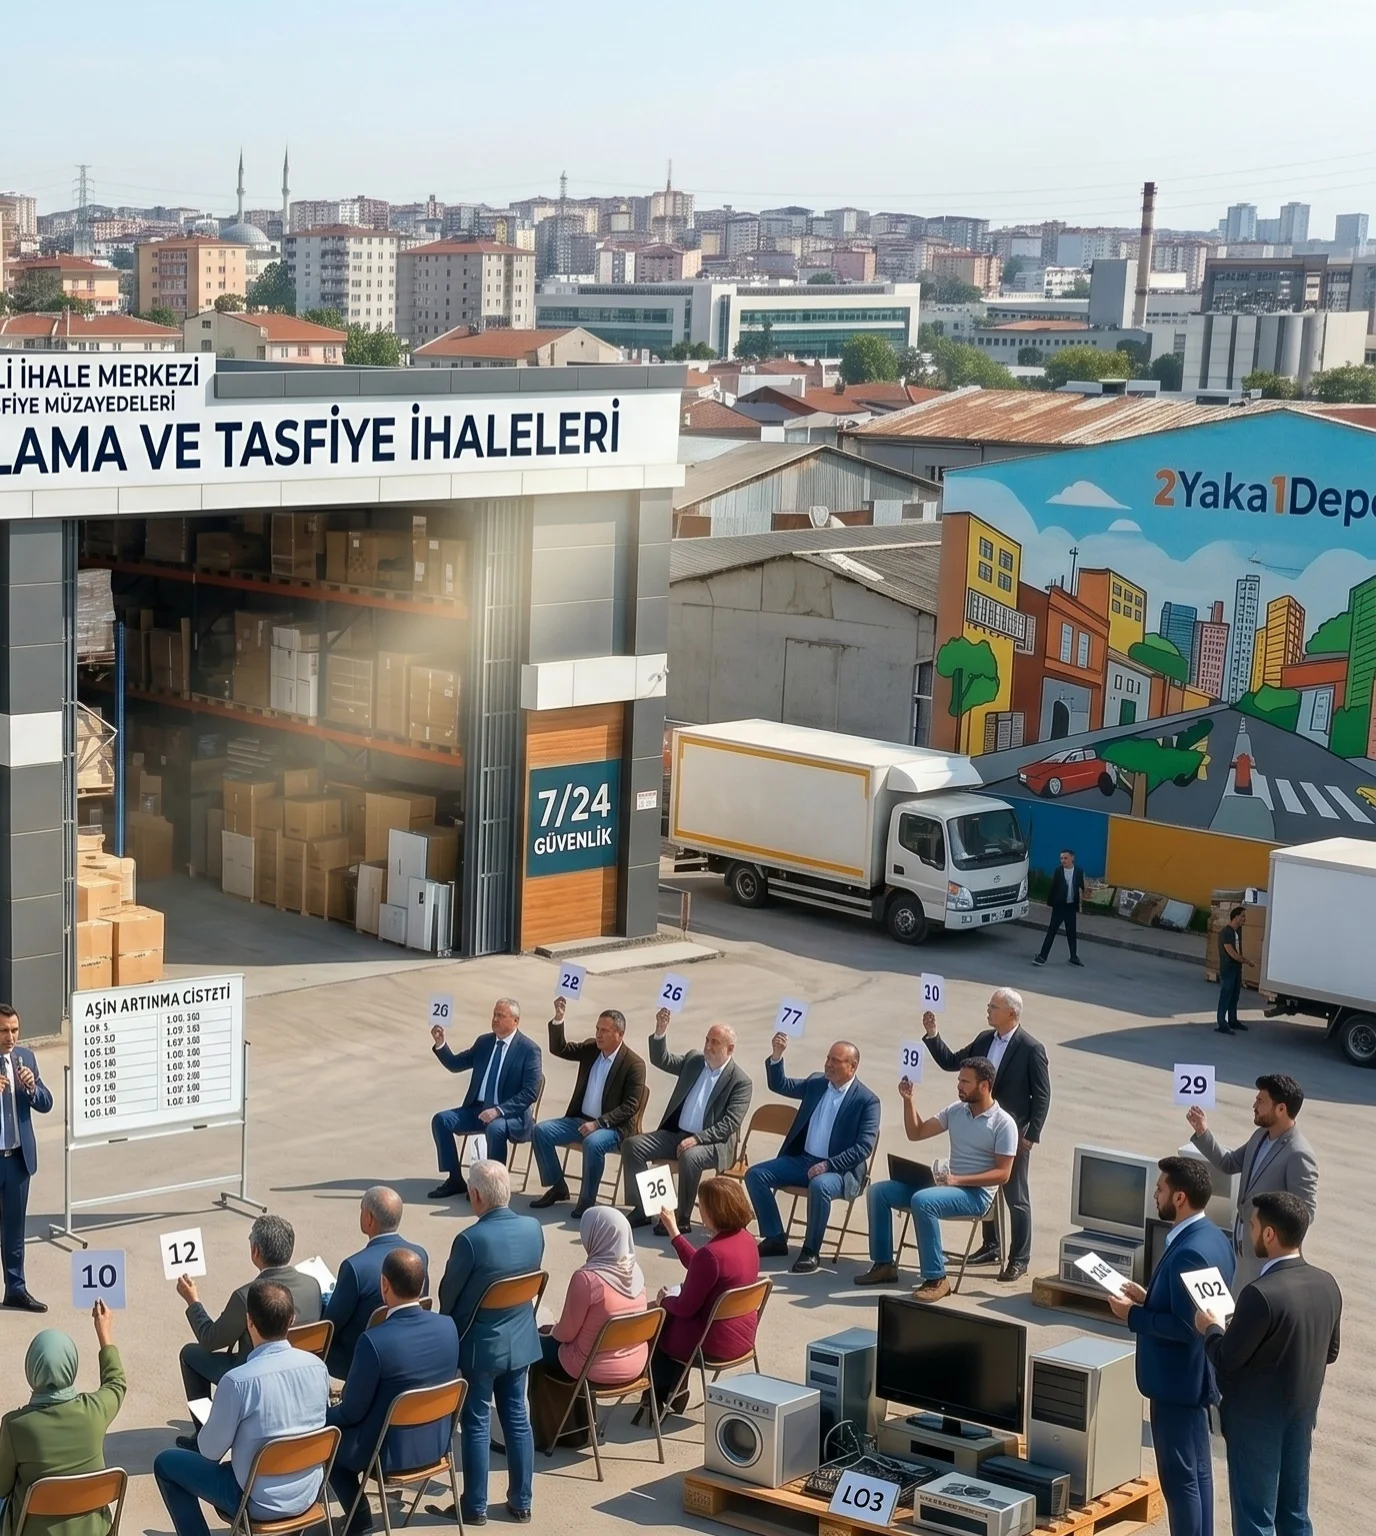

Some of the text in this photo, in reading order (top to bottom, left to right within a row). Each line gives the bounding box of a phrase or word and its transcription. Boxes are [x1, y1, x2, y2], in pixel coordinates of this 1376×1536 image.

[21, 357, 91, 389] İHALE
[98, 356, 200, 387] MERKEZİ
[45, 389, 175, 414] MÜZAYEDELERİ
[137, 421, 201, 470] VE
[220, 404, 396, 467] TASFİYE
[409, 397, 621, 461] İHALELERİ
[1154, 469, 1376, 527] 2Yaka1Dep
[538, 783, 611, 828] 7/24
[534, 825, 612, 855] GÜVENLİK
[662, 983, 683, 1001] 26
[85, 998, 116, 1020] AŞİN
[120, 992, 180, 1013] ARTINMA
[781, 1007, 803, 1025] 77
[1178, 1075, 1208, 1095] 29
[168, 1241, 198, 1265] 12
[81, 1264, 117, 1289] 10
[1194, 1281, 1227, 1300] 102
